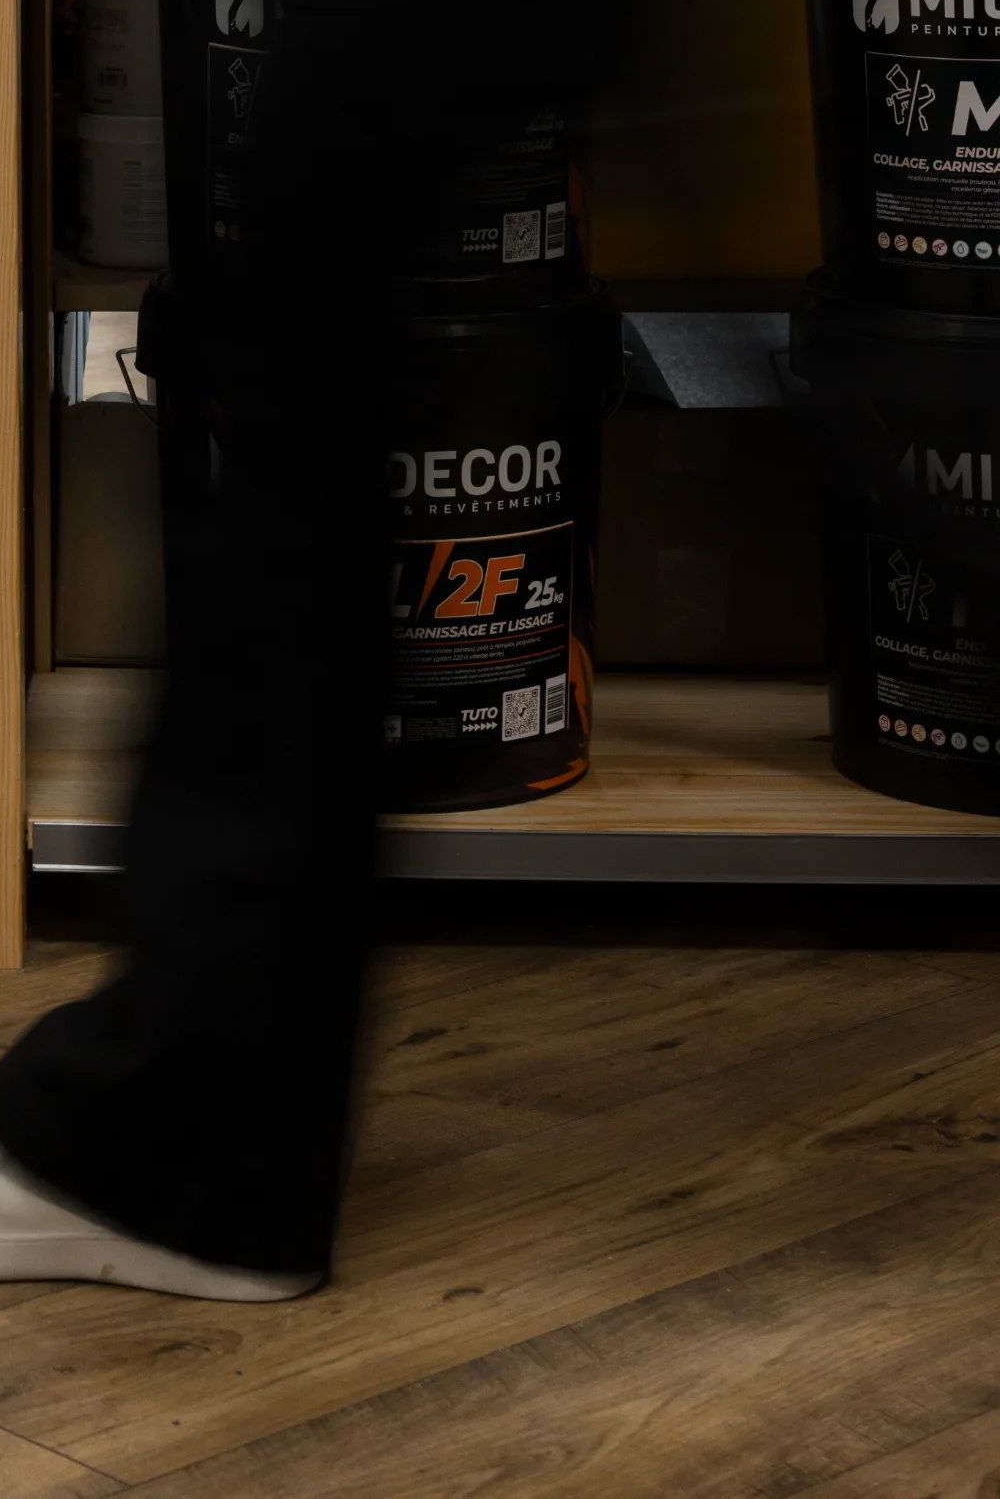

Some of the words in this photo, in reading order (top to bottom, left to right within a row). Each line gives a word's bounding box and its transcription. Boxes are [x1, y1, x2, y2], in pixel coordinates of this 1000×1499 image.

[873, 153, 930, 172] COLLAGE,
[461, 228, 499, 242] TUTO
[429, 491, 561, 515] REVÊTEMENTS
[434, 554, 526, 619] 2F
[490, 622, 507, 635] ET
[507, 612, 555, 632] LISSAGE
[875, 635, 930, 661] COLLAGE,
[461, 705, 499, 723] TUTO
